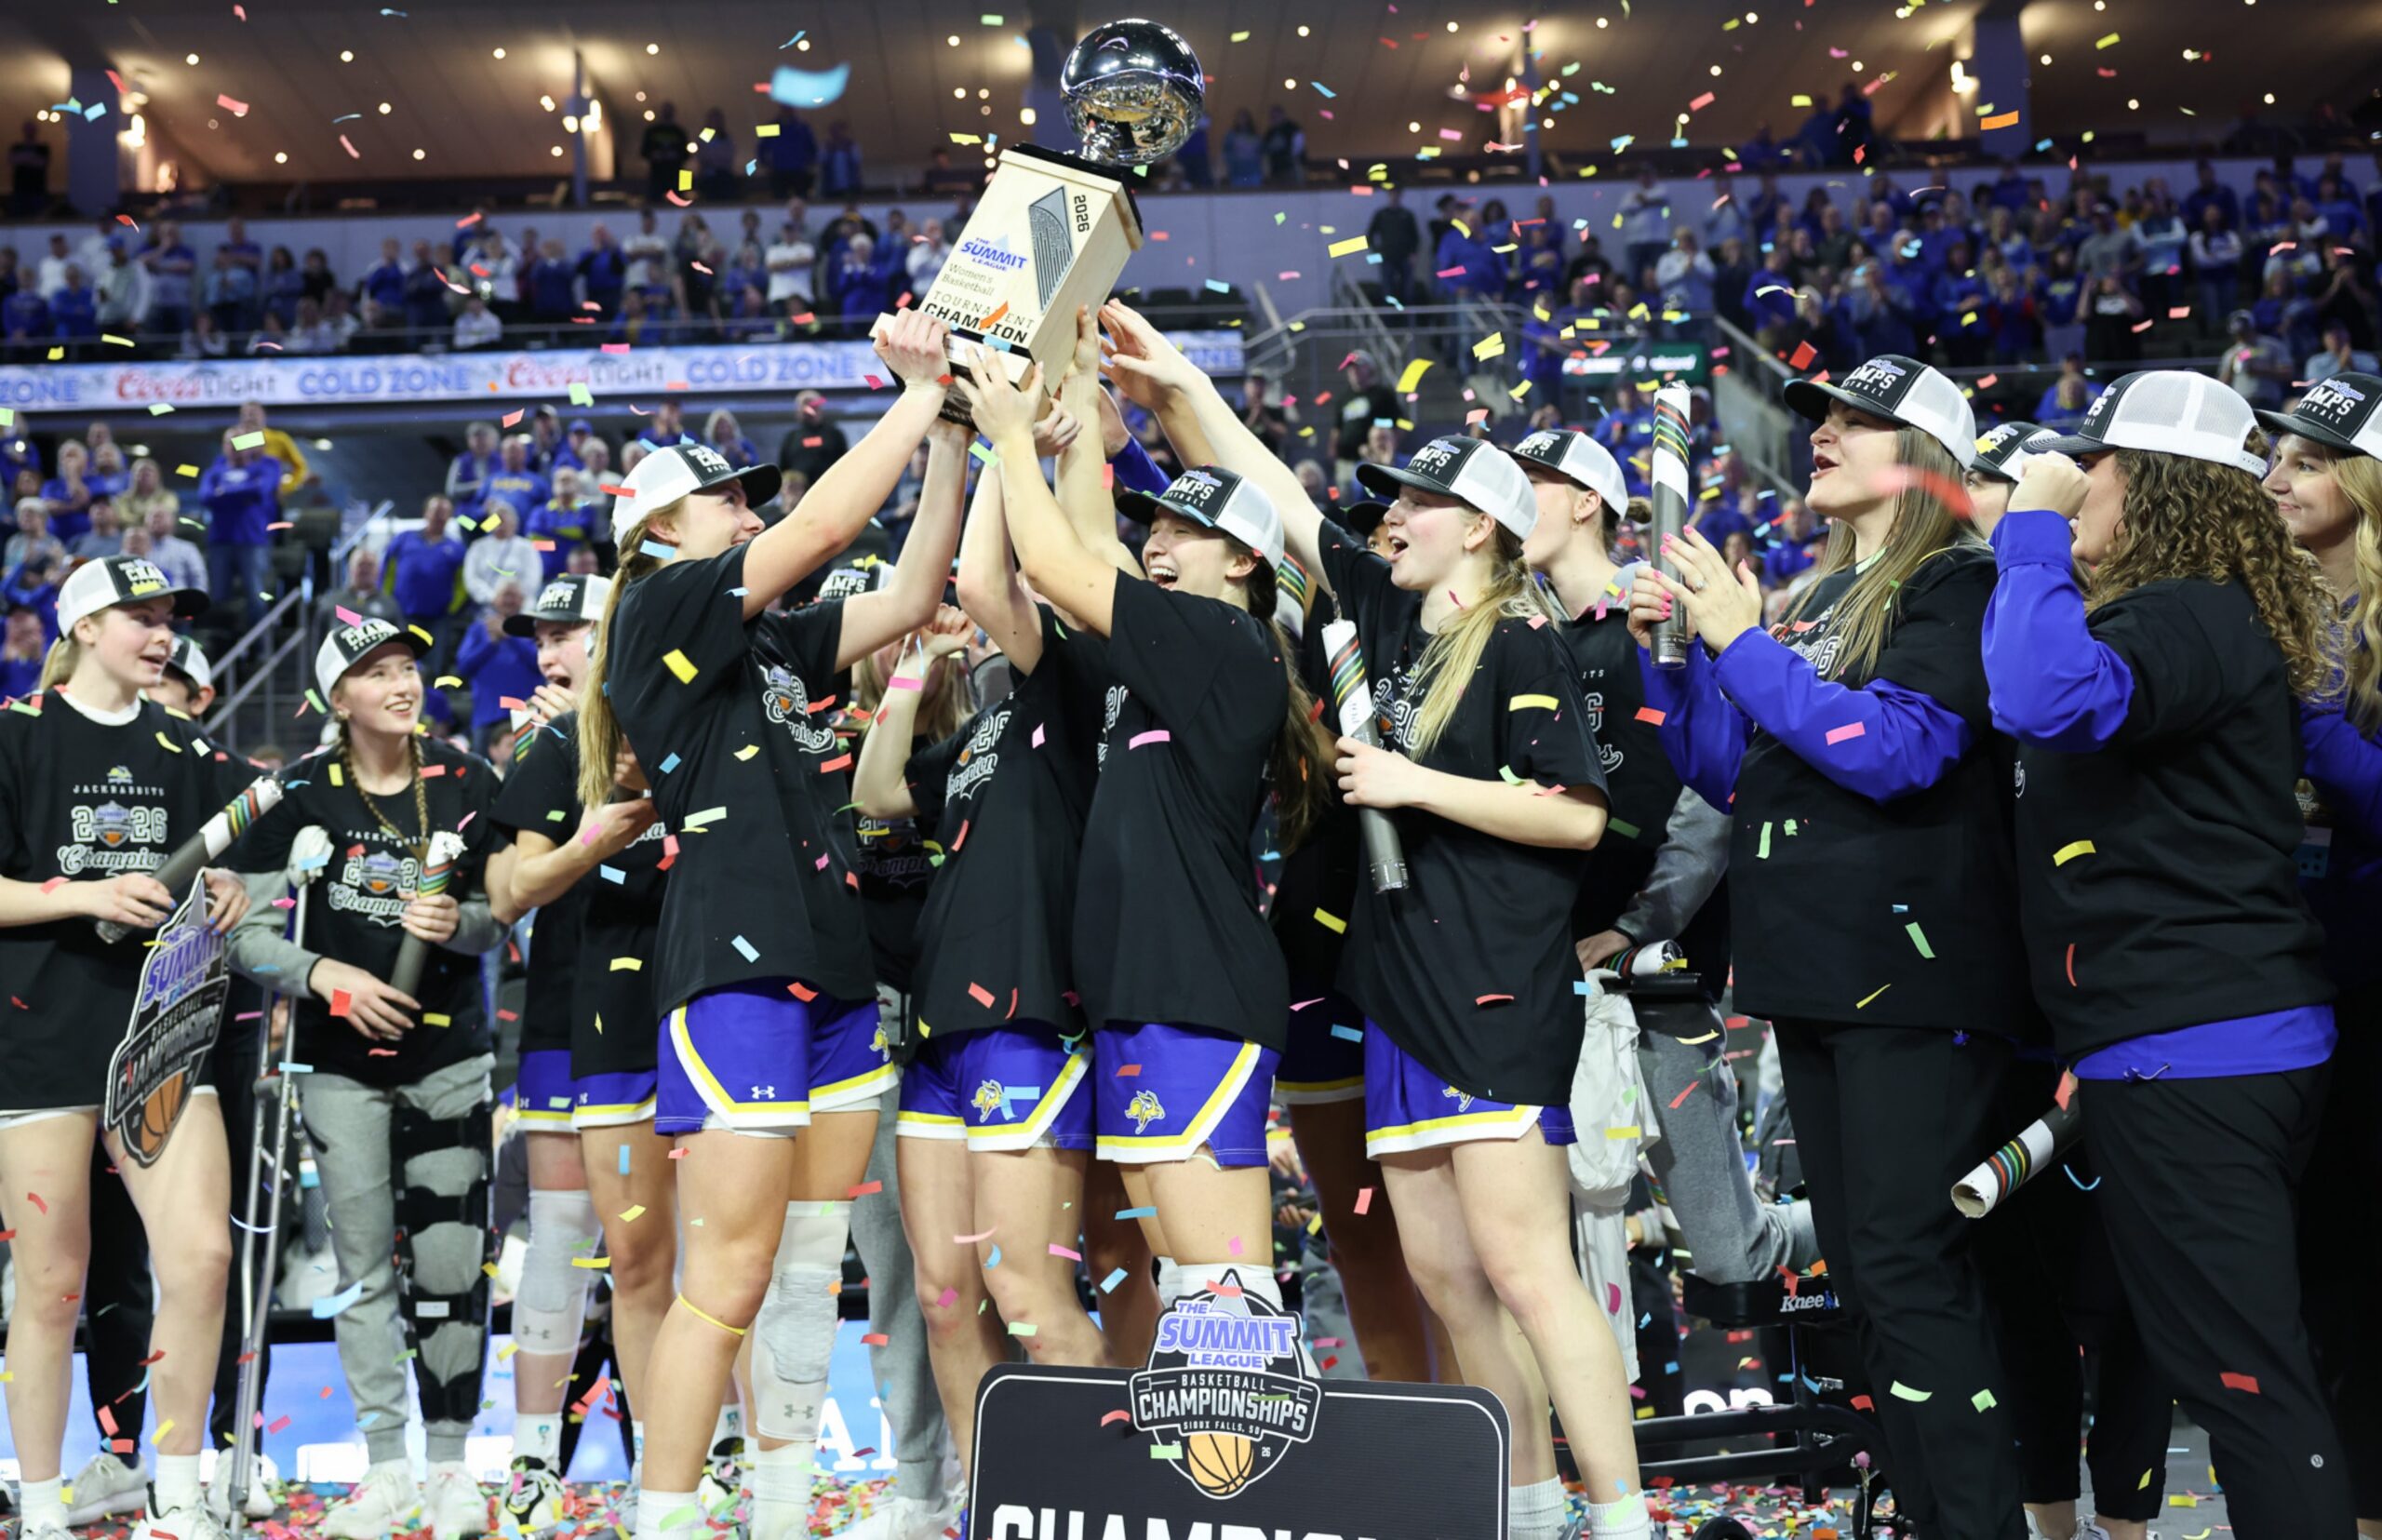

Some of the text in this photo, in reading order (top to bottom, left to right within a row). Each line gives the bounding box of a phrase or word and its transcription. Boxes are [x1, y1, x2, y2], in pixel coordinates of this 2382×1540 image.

[1074, 194, 1090, 233] 2026
[961, 241, 1027, 269] SUMMIT
[971, 258, 1008, 272] LEAGUE
[942, 274, 995, 296] Basketball
[933, 290, 1035, 328] TOURNAENT
[925, 302, 1028, 343] CHAMION
[686, 353, 857, 384] COLD ZONE
[204, 375, 276, 397] LIGHT
[298, 365, 471, 395] COLD ZONE
[73, 784, 165, 797] JACKRABBITS
[1177, 1302, 1209, 1314] THE
[1159, 1317, 1293, 1355] SUMMIT
[1189, 1352, 1264, 1369] LEAGUE
[1182, 1373, 1266, 1392] BASKETBALL
[1139, 1387, 1308, 1433] CHAMPIONSHIPS
[1183, 1421, 1211, 1431] SIOUX
[1214, 1421, 1246, 1433] FALLS,
[1261, 1446, 1272, 1458] 26
